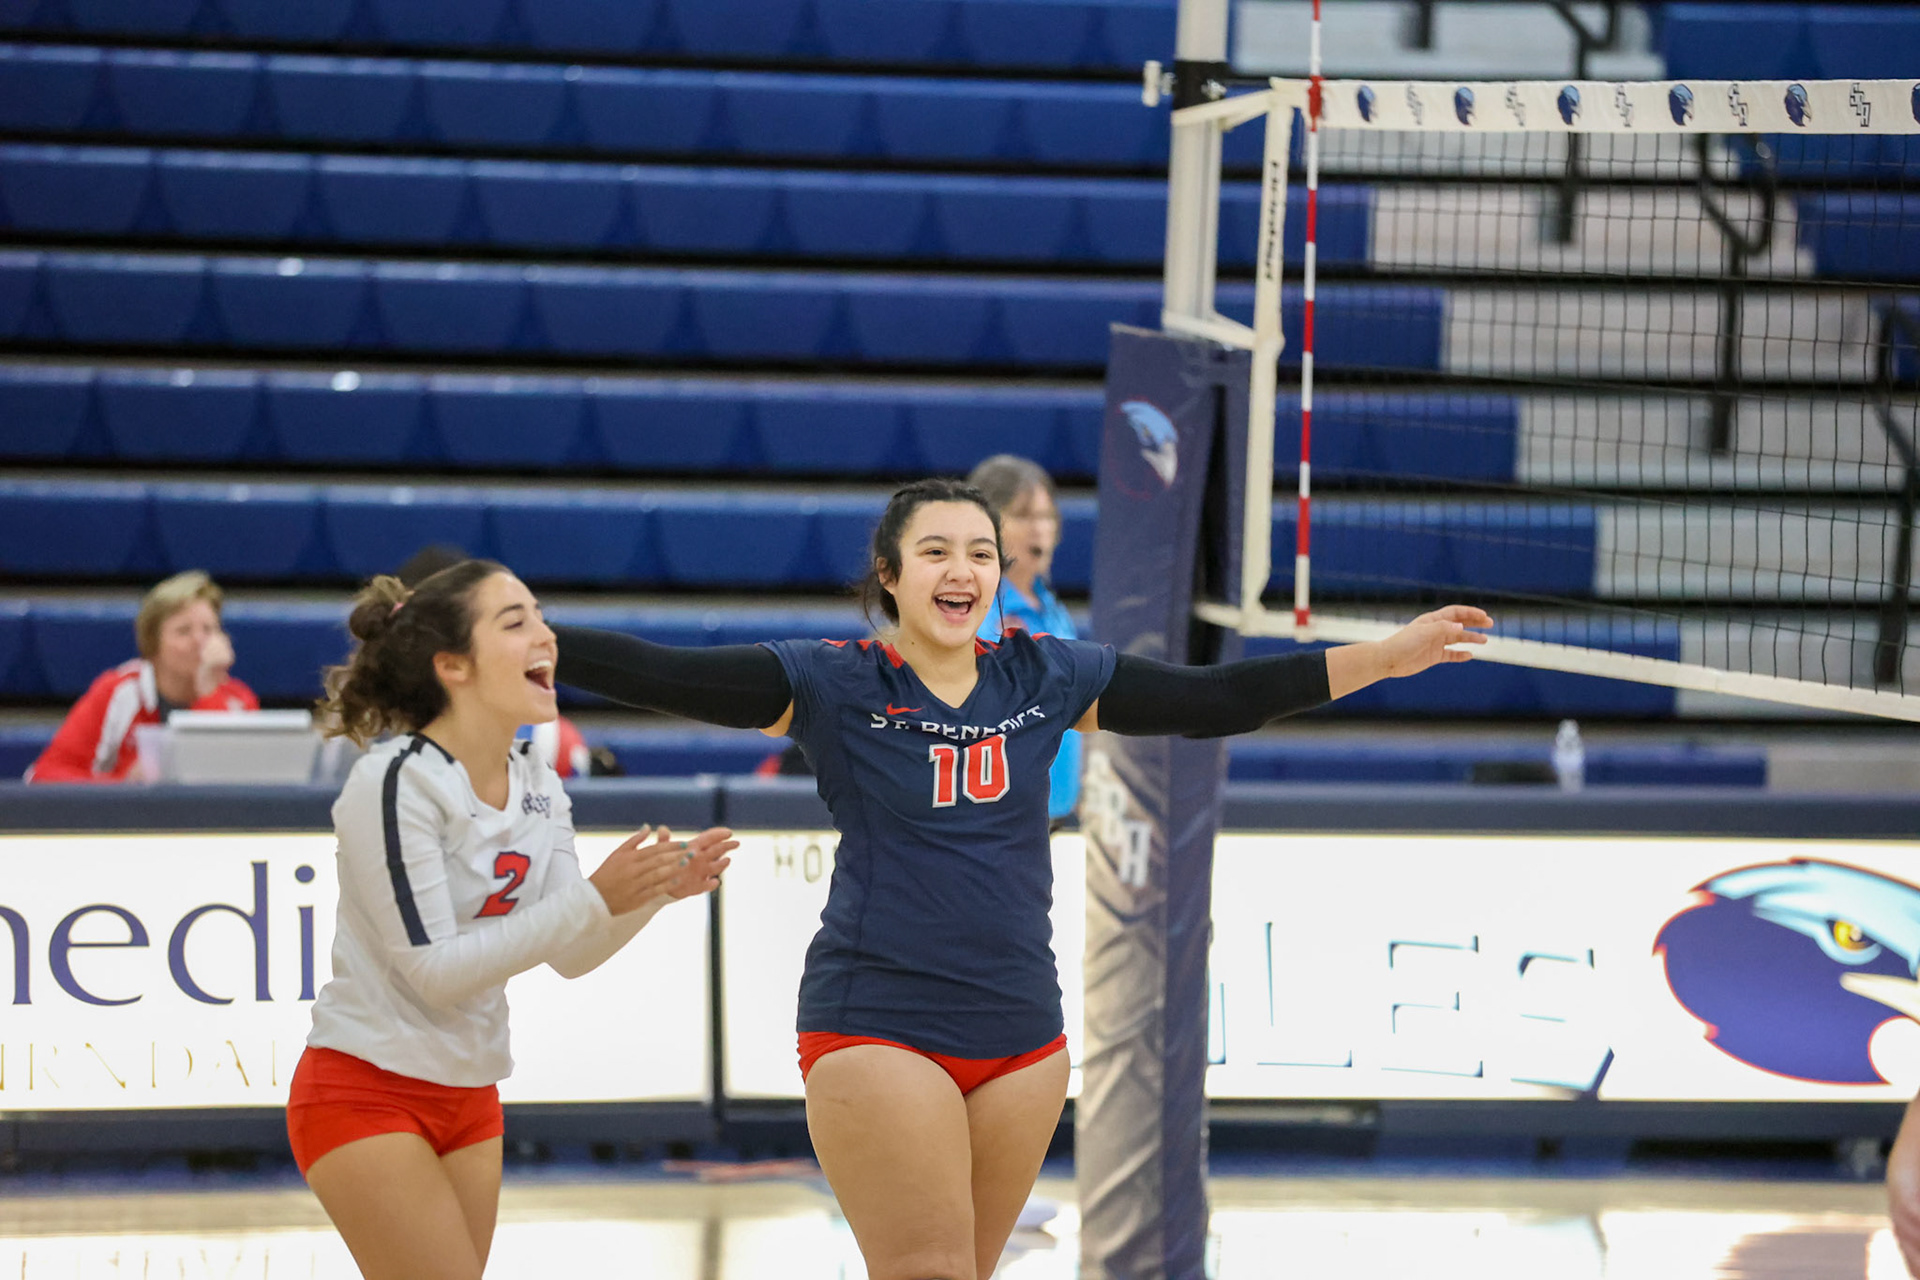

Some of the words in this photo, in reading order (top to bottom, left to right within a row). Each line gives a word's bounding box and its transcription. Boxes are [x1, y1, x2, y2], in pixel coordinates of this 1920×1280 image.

[928, 733, 1011, 809] 10
[473, 850, 532, 919] 2
[773, 844, 838, 883] HO
[1205, 920, 1614, 1095] LES
